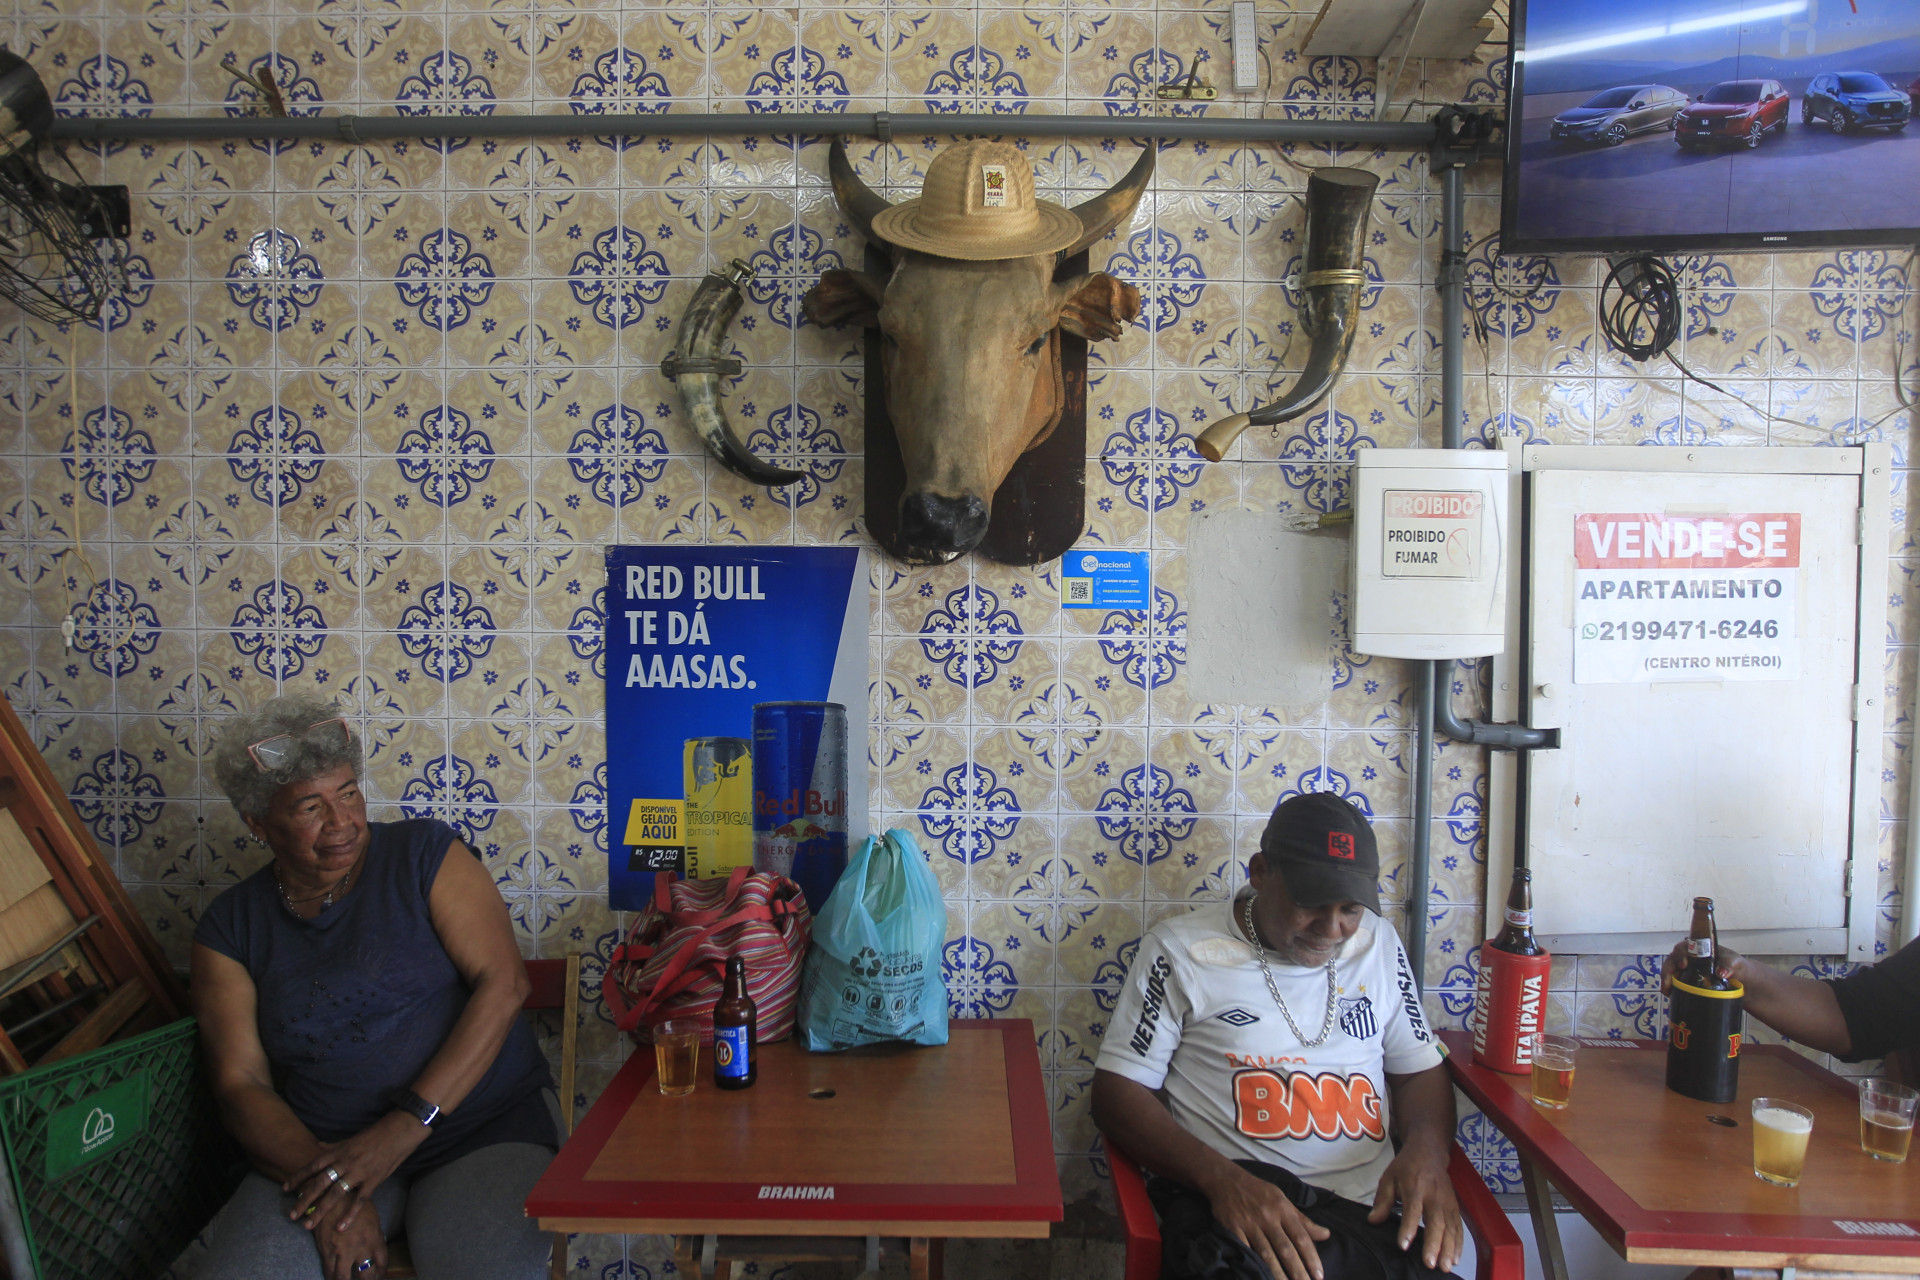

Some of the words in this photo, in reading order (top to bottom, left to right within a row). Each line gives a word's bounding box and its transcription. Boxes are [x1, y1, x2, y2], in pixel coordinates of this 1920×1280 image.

[1391, 496, 1475, 515] PROIBIDO
[1388, 530, 1446, 543] PROIBIDO
[1588, 521, 1787, 558] VENDE-SE
[1395, 551, 1438, 563] FUMAR
[626, 565, 684, 600] RED
[693, 566, 766, 600] BULL
[1581, 579, 1782, 600] APARTAMENTO
[625, 611, 658, 645] TE
[668, 602, 711, 645] DÁ
[1599, 619, 1779, 641] 2199471-6246
[625, 654, 757, 690] AAASAS.
[1644, 657, 1711, 671] (CENTRO
[1715, 654, 1782, 670] NITÉROI)
[640, 805, 677, 814] DISPONÍVEL
[755, 789, 800, 816] Red
[804, 790, 846, 817] Bull
[641, 814, 677, 825] GELADO
[641, 825, 677, 840] AQUI
[687, 846, 698, 880] Bull
[882, 960, 923, 977] SECOS
[1129, 955, 1172, 1058] NETSHOES
[1474, 966, 1492, 1056] ITAIPAVA
[1516, 974, 1543, 1065] ITAIPAVA
[1232, 1070, 1386, 1142] BMG
[757, 1185, 835, 1200] BRAHMA
[1832, 1220, 1920, 1236] BRAHMA
